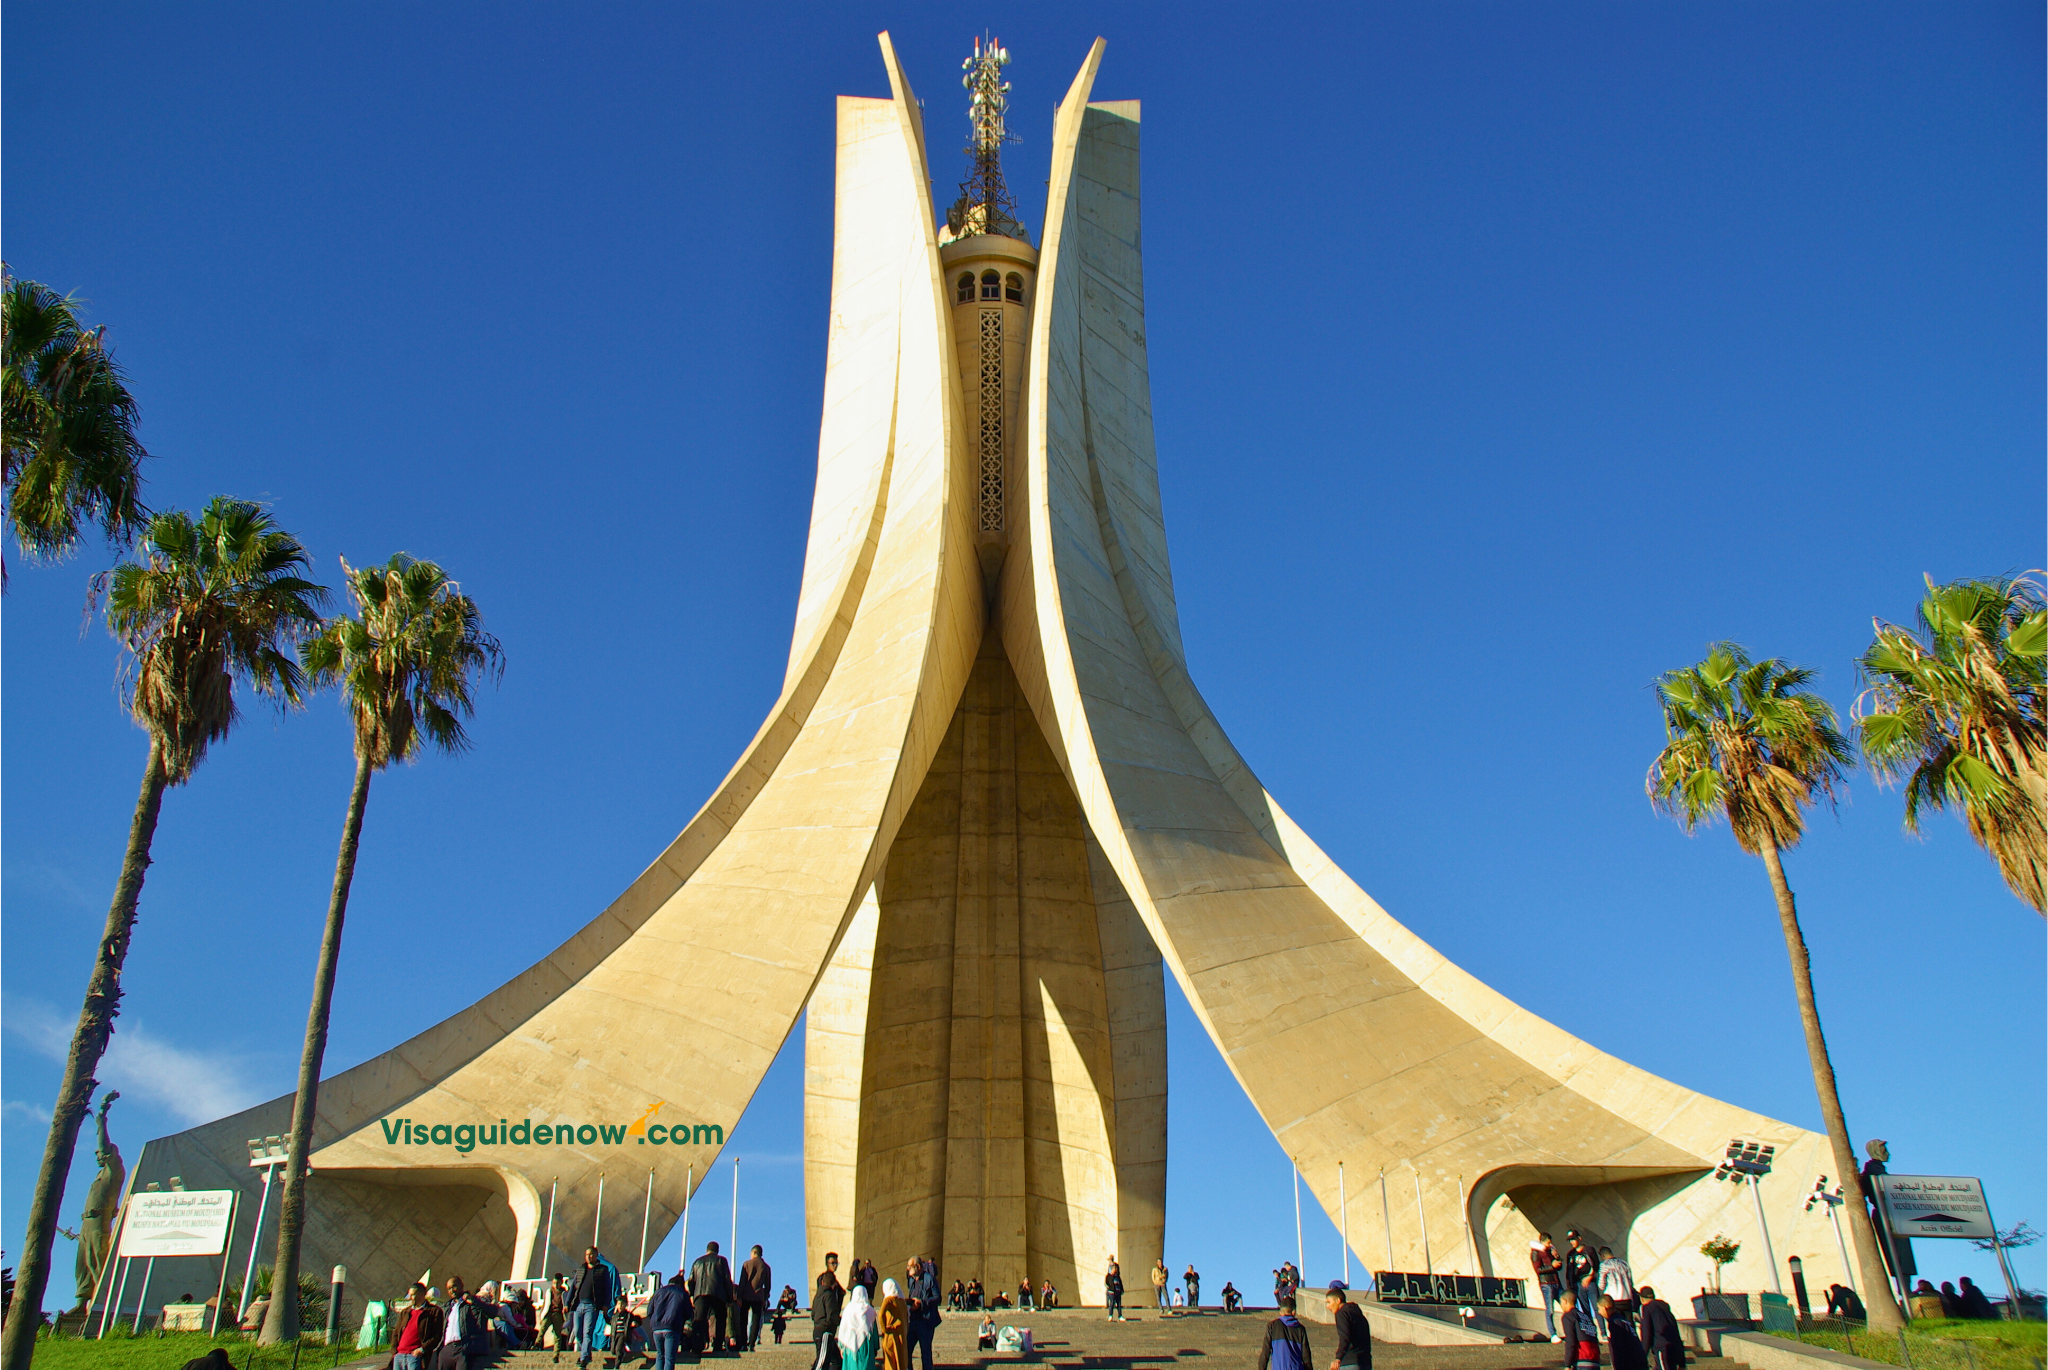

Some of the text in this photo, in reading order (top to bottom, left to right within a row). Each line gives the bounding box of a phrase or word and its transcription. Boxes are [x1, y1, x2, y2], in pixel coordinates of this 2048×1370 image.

[1922, 1180, 1945, 1193] الوطني
[1947, 1183, 1971, 1192] المتحف
[172, 1196, 196, 1208] الوطني
[197, 1196, 222, 1206] المتحف
[1890, 1192, 1979, 1203] NATIONAL MUSEUM OF MOUDJAHID
[162, 1209, 185, 1217] MUSEUM
[185, 1208, 193, 1216] OF
[1893, 1202, 1983, 1213] MUSÉE NATIONAL DU MOUDJAHID
[1921, 1224, 1937, 1232] Accès
